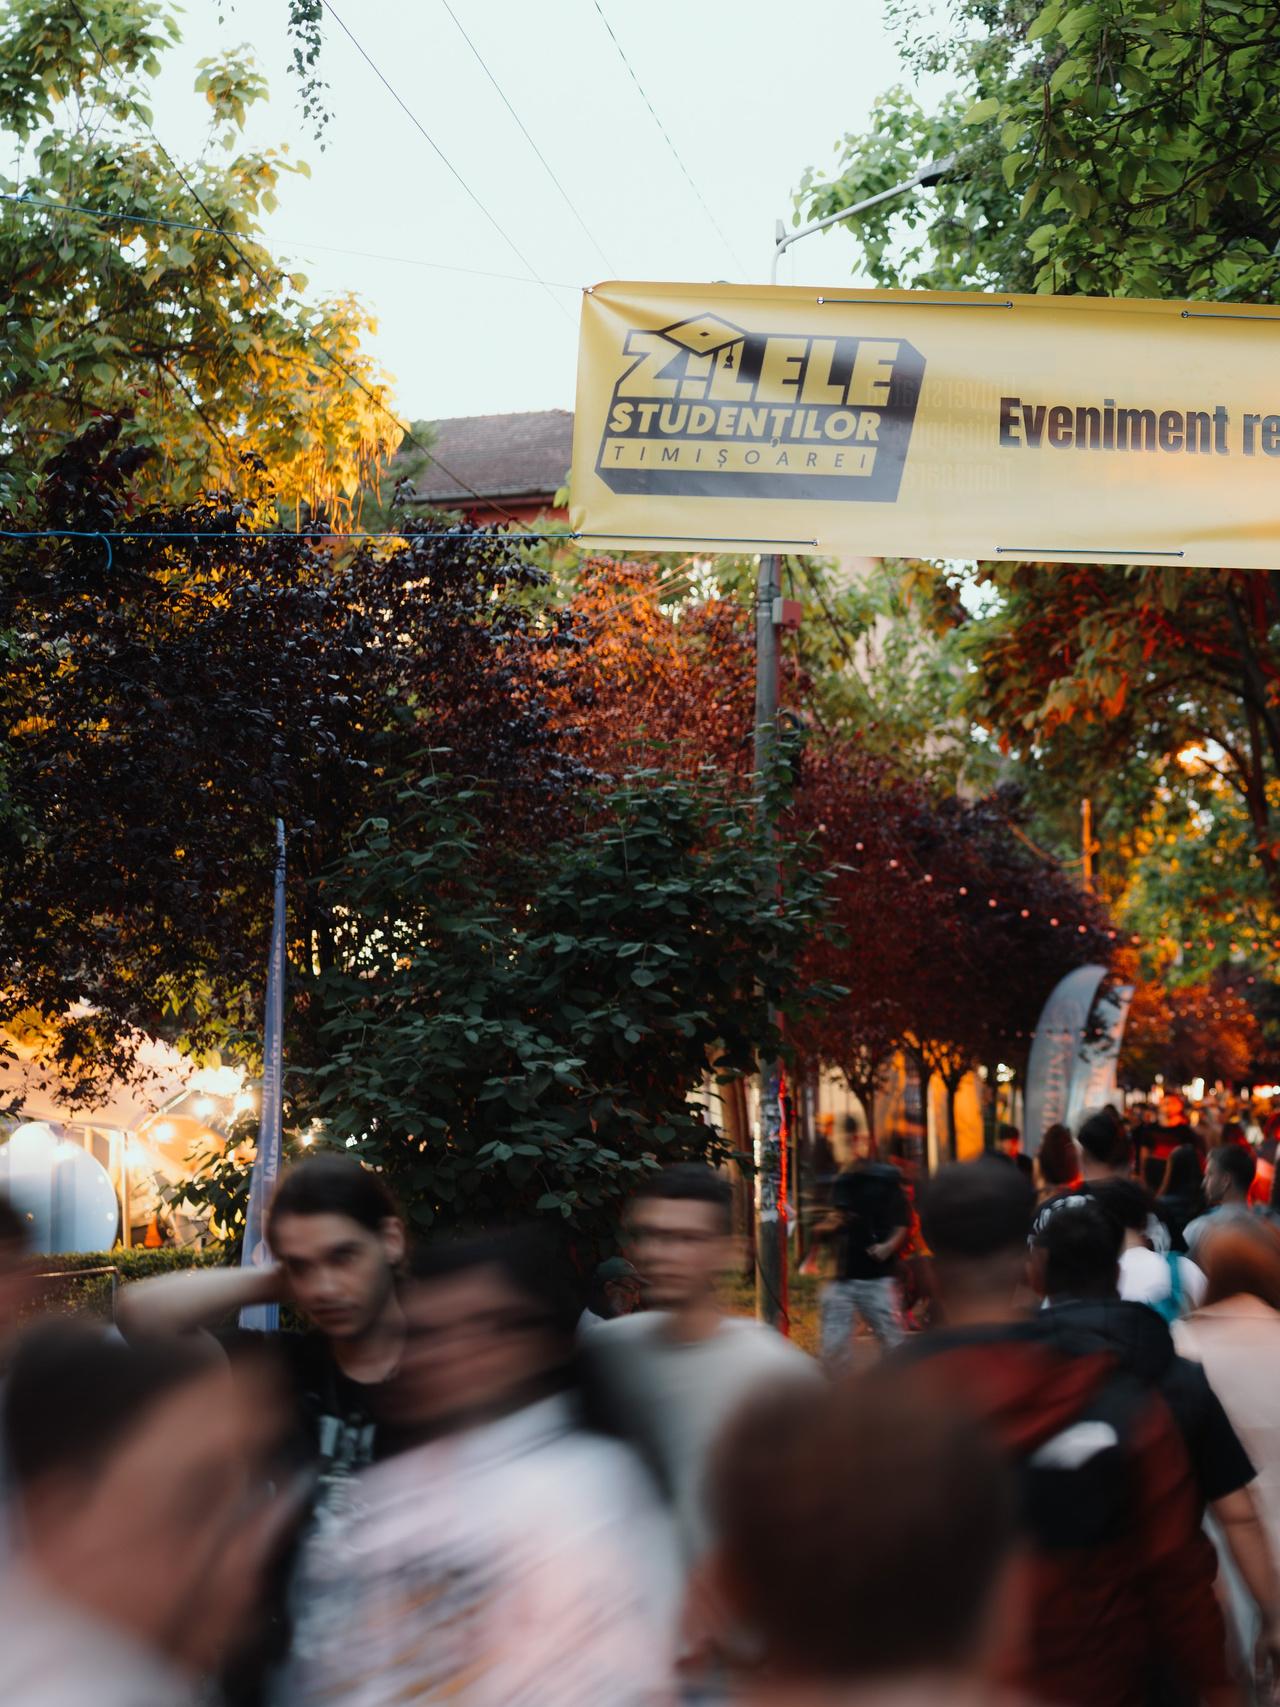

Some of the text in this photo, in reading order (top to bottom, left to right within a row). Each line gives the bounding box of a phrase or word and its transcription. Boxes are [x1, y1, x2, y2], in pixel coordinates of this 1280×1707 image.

[615, 331, 901, 407] ZILELE
[609, 402, 882, 448] STUDENȚILOR
[999, 397, 1230, 455] Eveniment
[613, 445, 868, 469] TIMIȘOAREI
